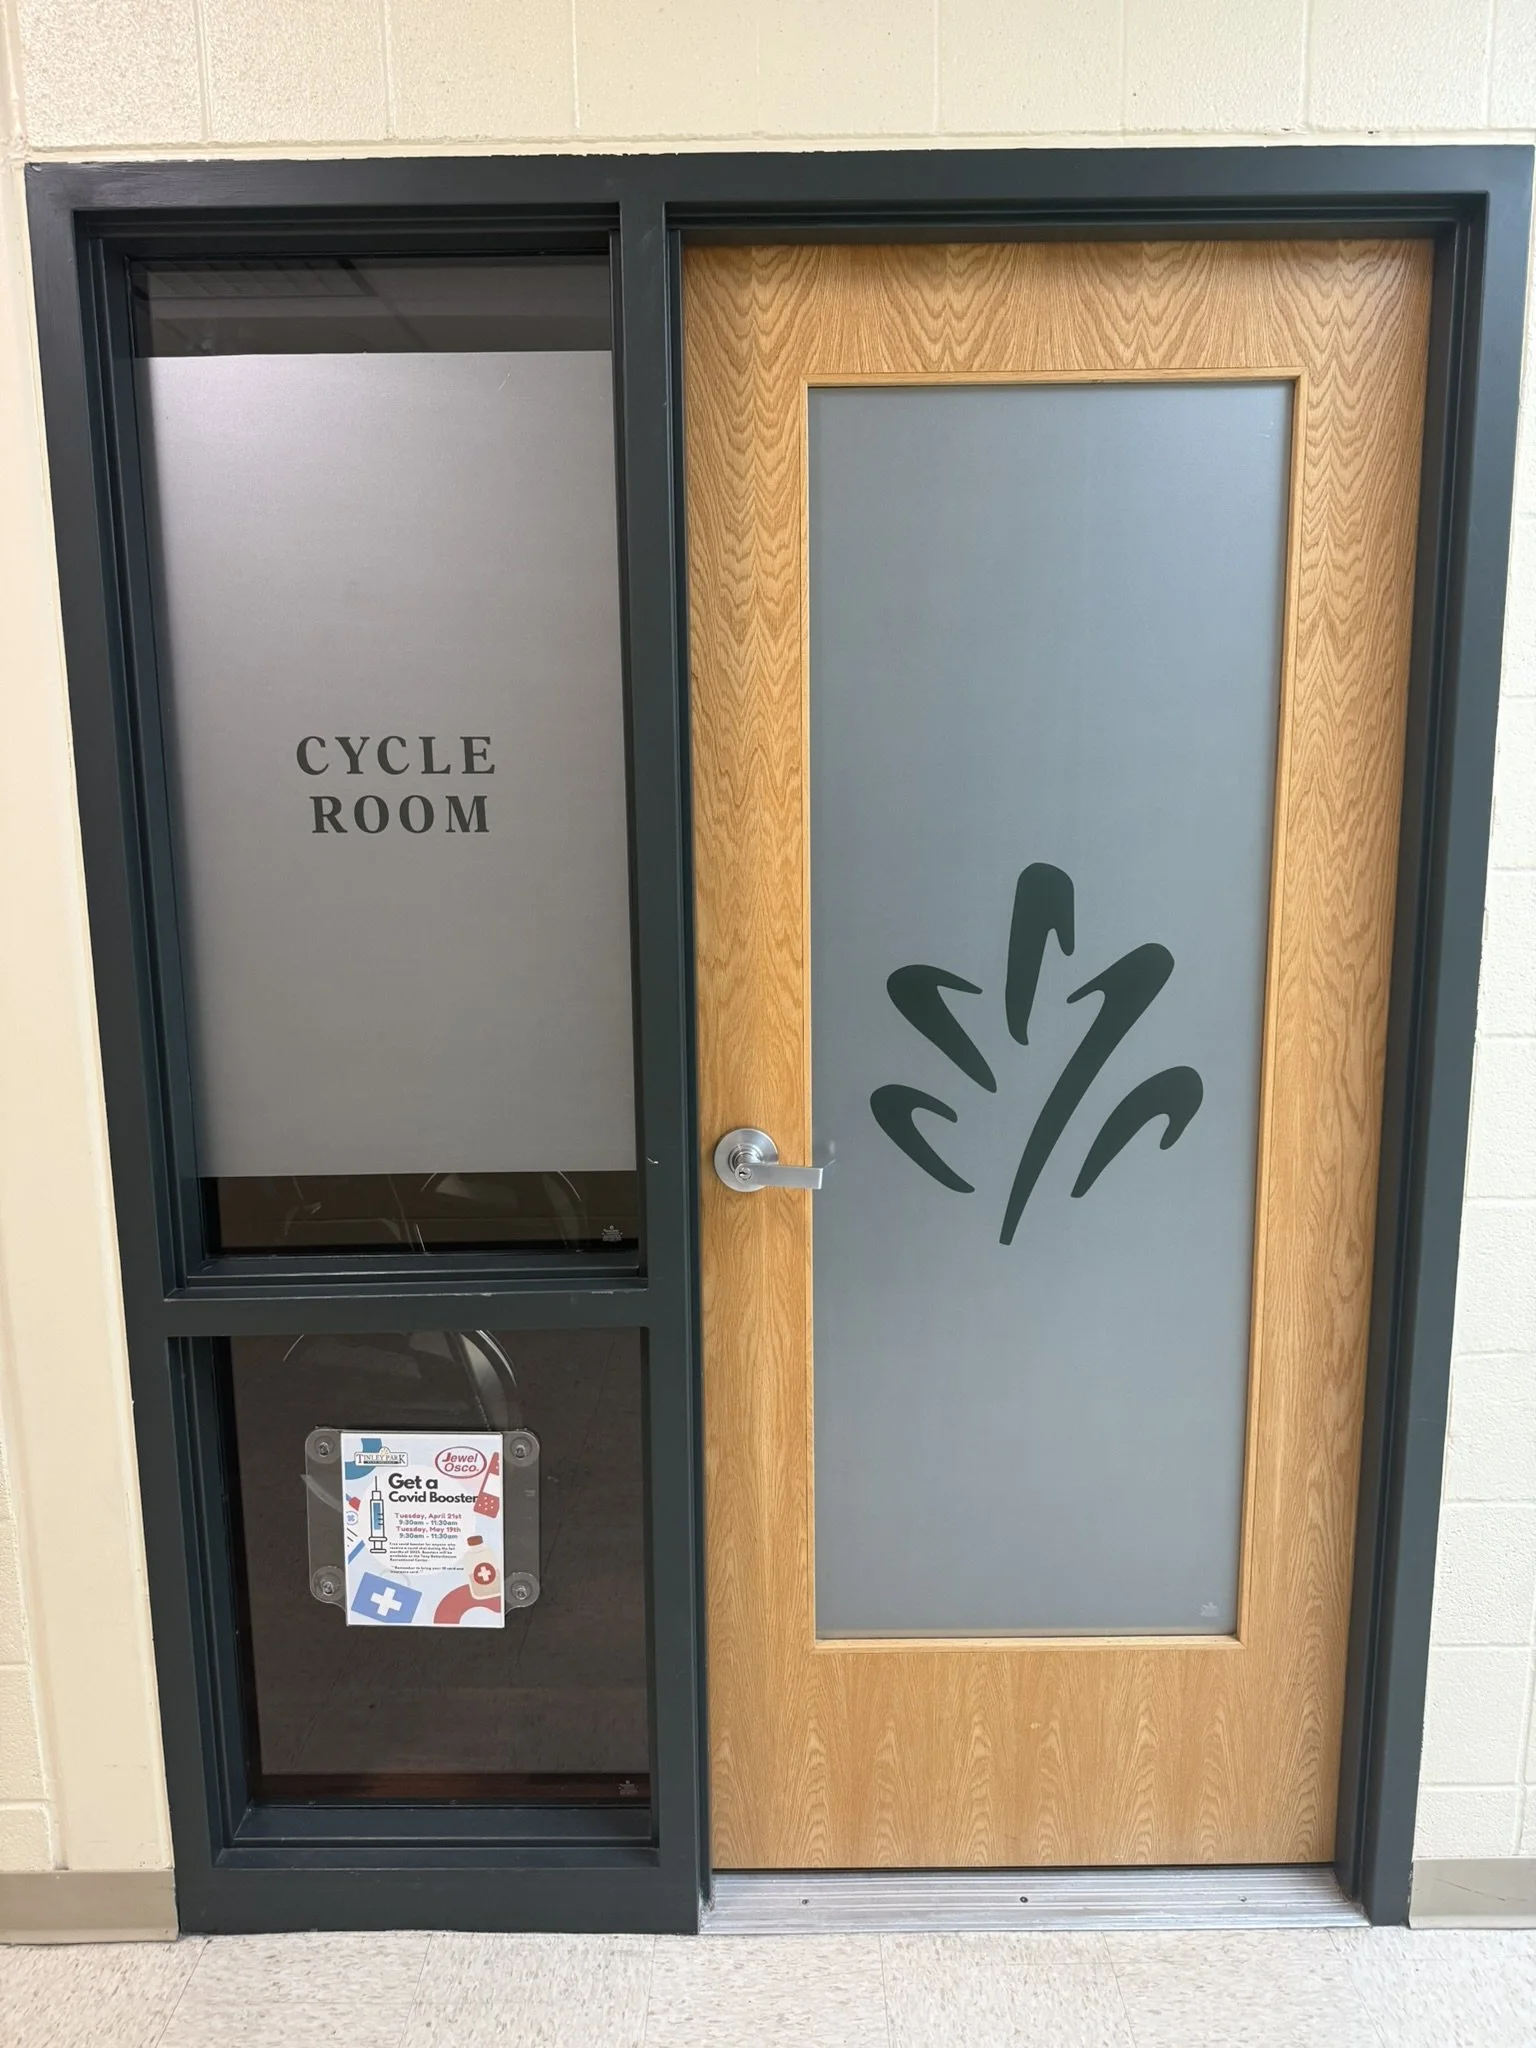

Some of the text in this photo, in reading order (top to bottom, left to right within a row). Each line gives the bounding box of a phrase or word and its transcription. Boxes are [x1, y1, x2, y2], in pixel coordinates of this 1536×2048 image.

[296, 735, 496, 776] CYCLE
[309, 794, 490, 834] ROOM
[356, 1454, 406, 1464] TINLEY PARK
[442, 1452, 478, 1463] Jewel
[444, 1463, 477, 1473] Osco
[388, 1473, 439, 1490] Get a
[388, 1491, 479, 1504] Covid Booster
[394, 1512, 427, 1520] Tuesday,
